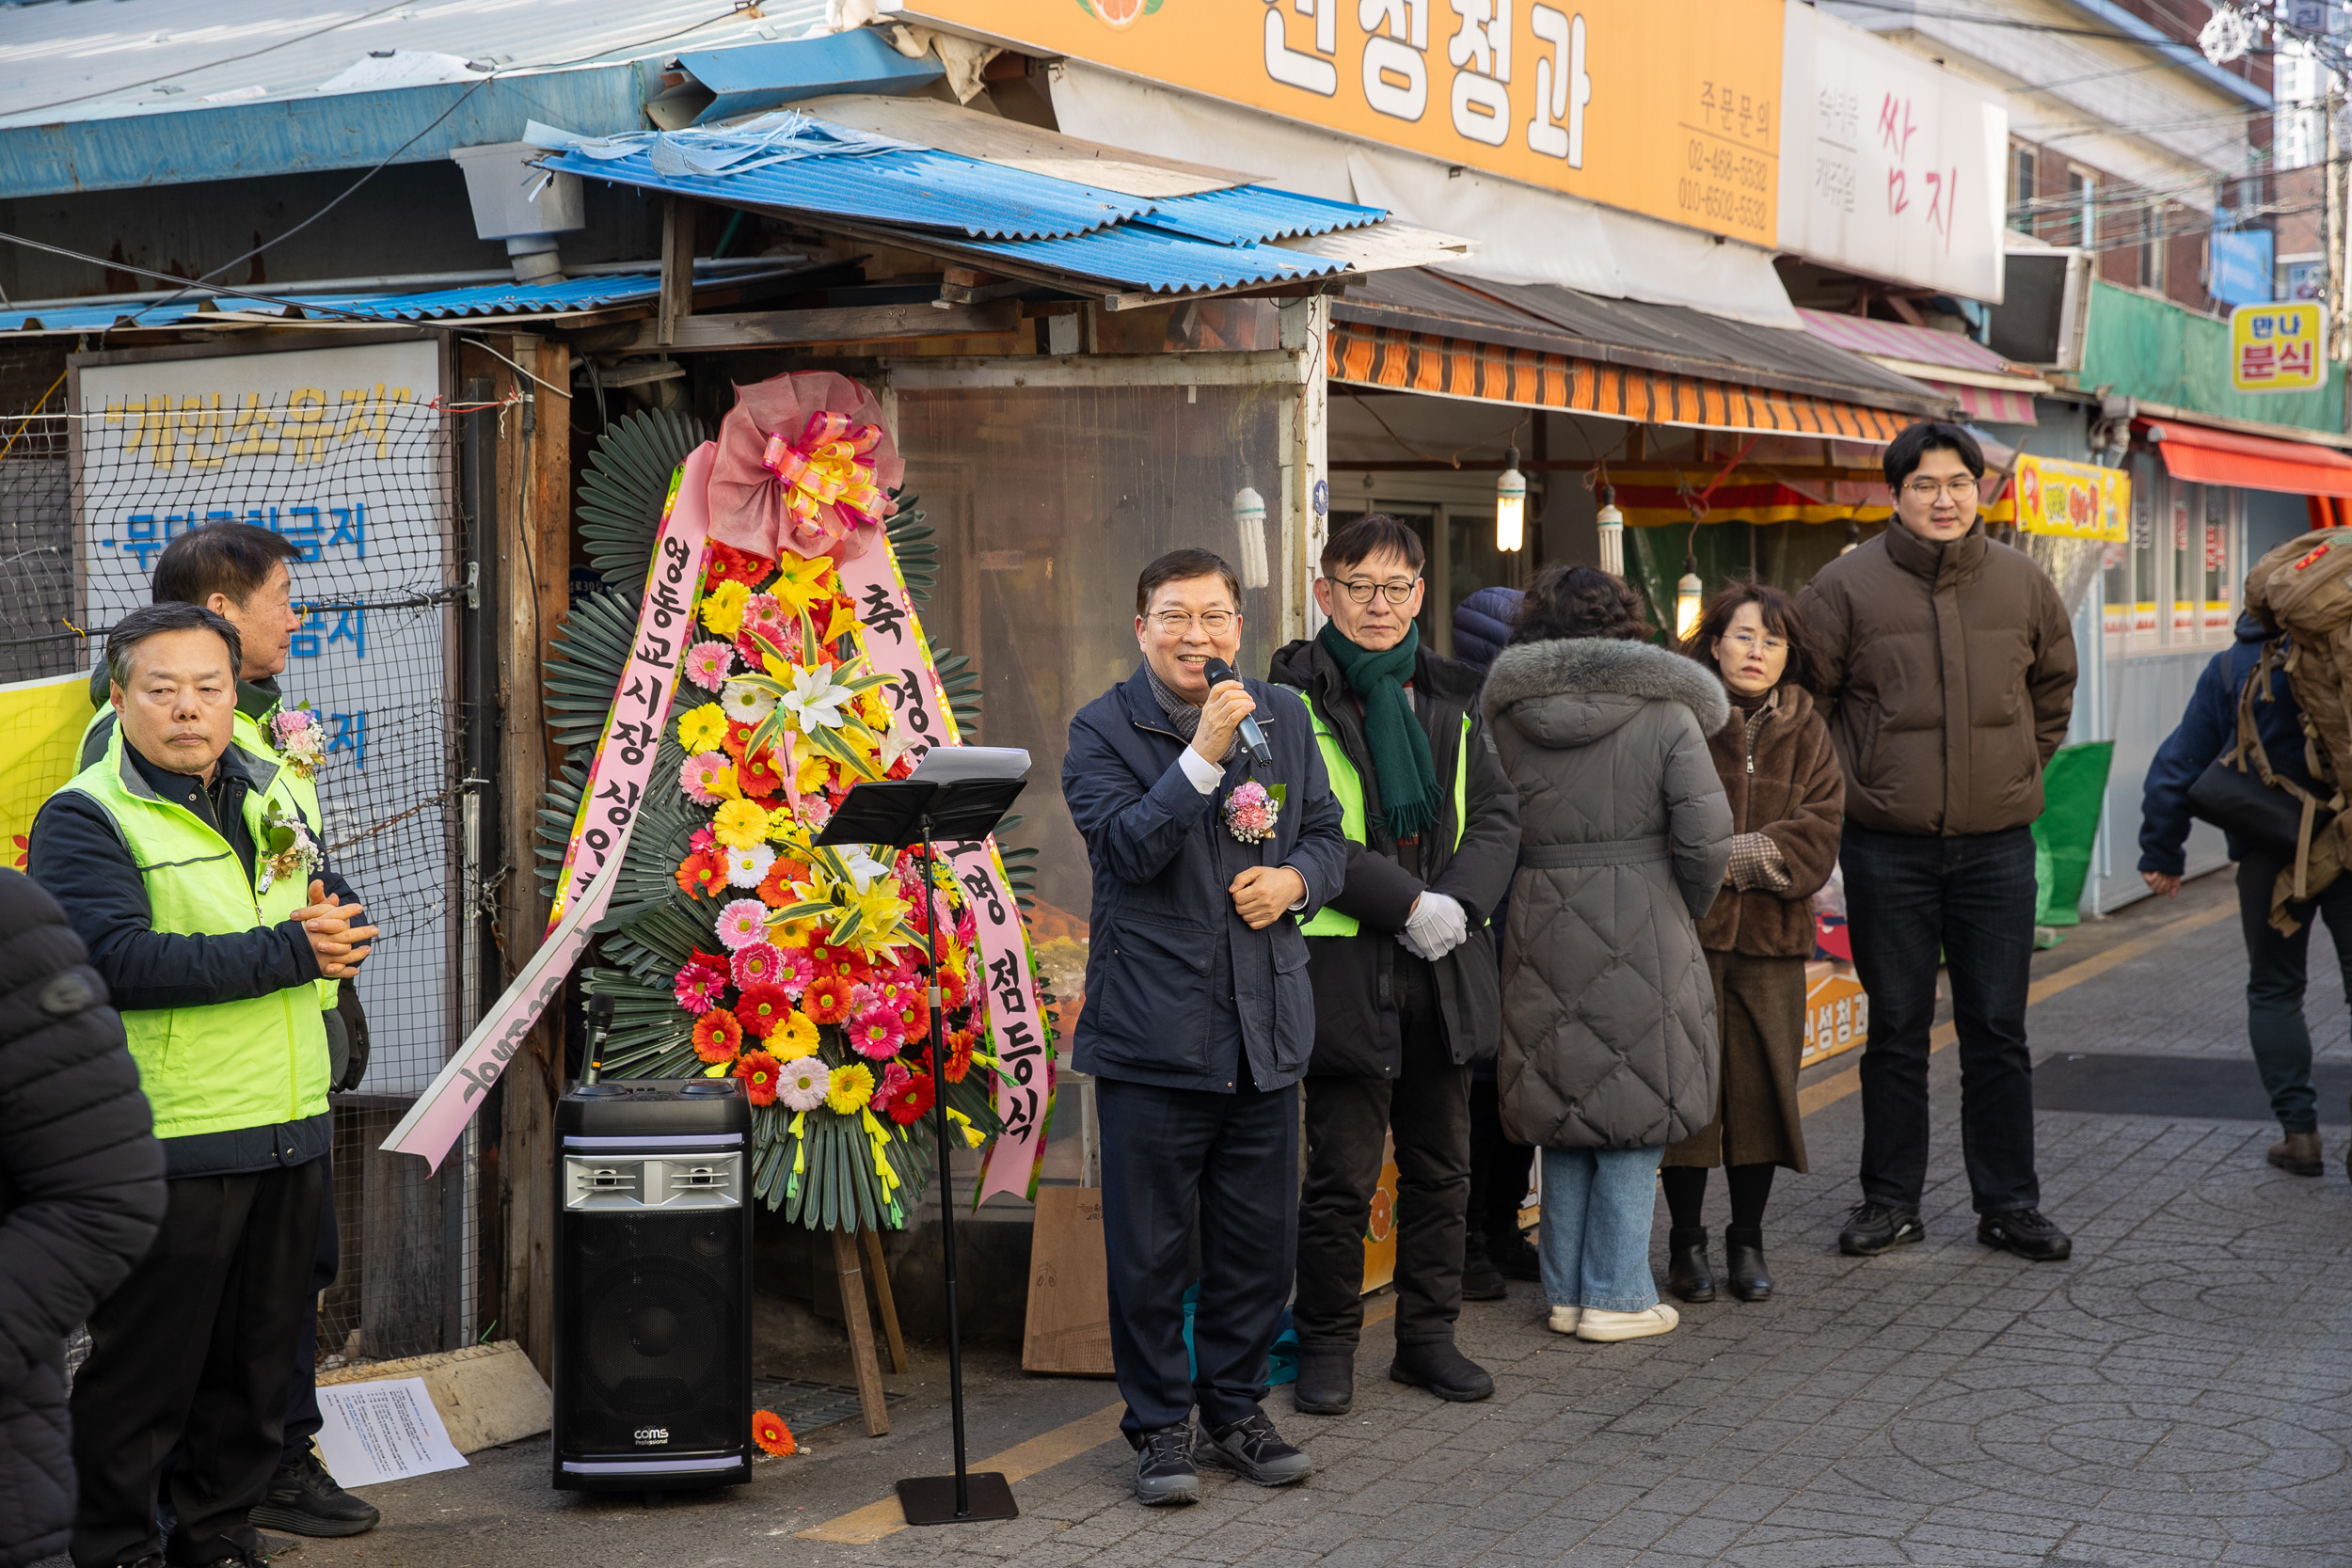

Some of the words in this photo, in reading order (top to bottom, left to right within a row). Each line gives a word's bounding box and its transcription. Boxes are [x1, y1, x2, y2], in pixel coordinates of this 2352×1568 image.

[1700, 80, 1771, 144] 주문문의
[1688, 139, 1769, 192] 02-468-5532
[2251, 314, 2303, 340] 만나
[2242, 341, 2312, 381] 분식
[864, 583, 905, 644] 축
[989, 948, 1042, 1146] 점등식
[634, 1428, 669, 1439] coms
